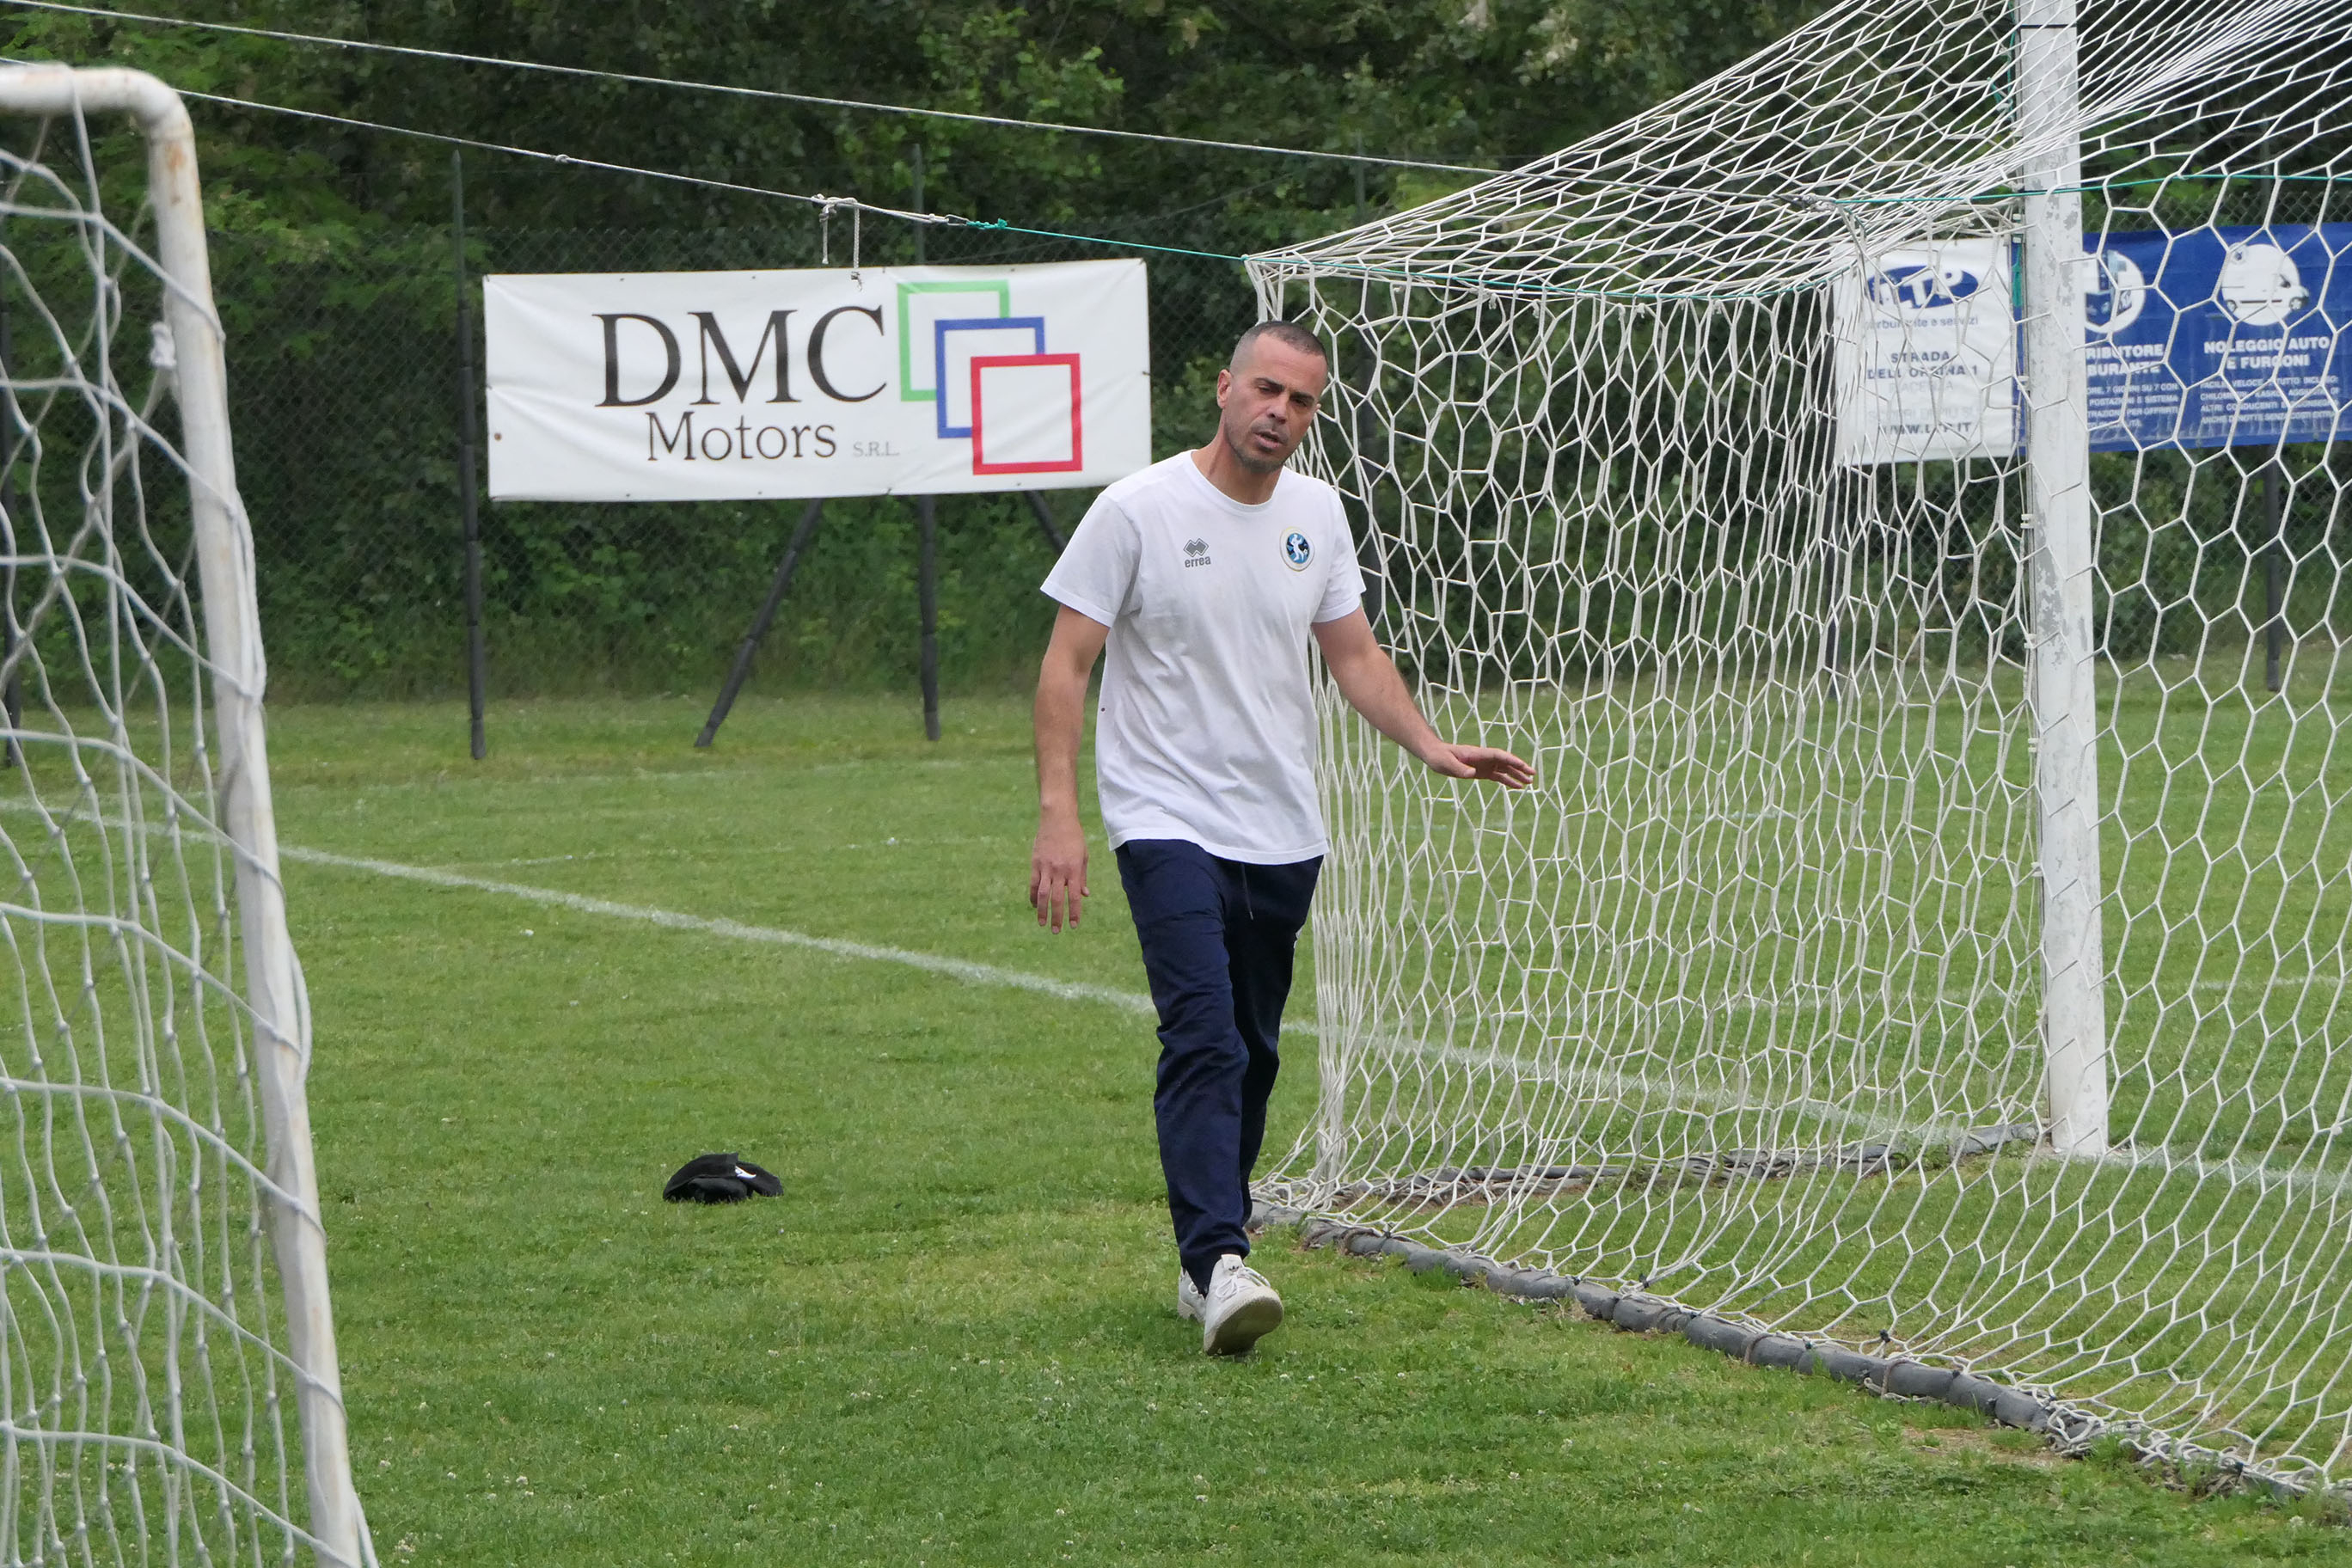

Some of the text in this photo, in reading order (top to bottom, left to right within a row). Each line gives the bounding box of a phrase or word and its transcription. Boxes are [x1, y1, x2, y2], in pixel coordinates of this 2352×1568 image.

[2203, 336, 2330, 354] NOLEGGIO AUTO
[591, 305, 888, 408] DMC
[1891, 351, 1951, 364] STRADA
[2226, 353, 2311, 370] E FURGONI
[1972, 365, 1978, 376] 1
[2141, 383, 2153, 392] SU
[2160, 383, 2179, 391] CON
[2089, 396, 2135, 407] POSTAZINI
[646, 412, 837, 462] Motors
